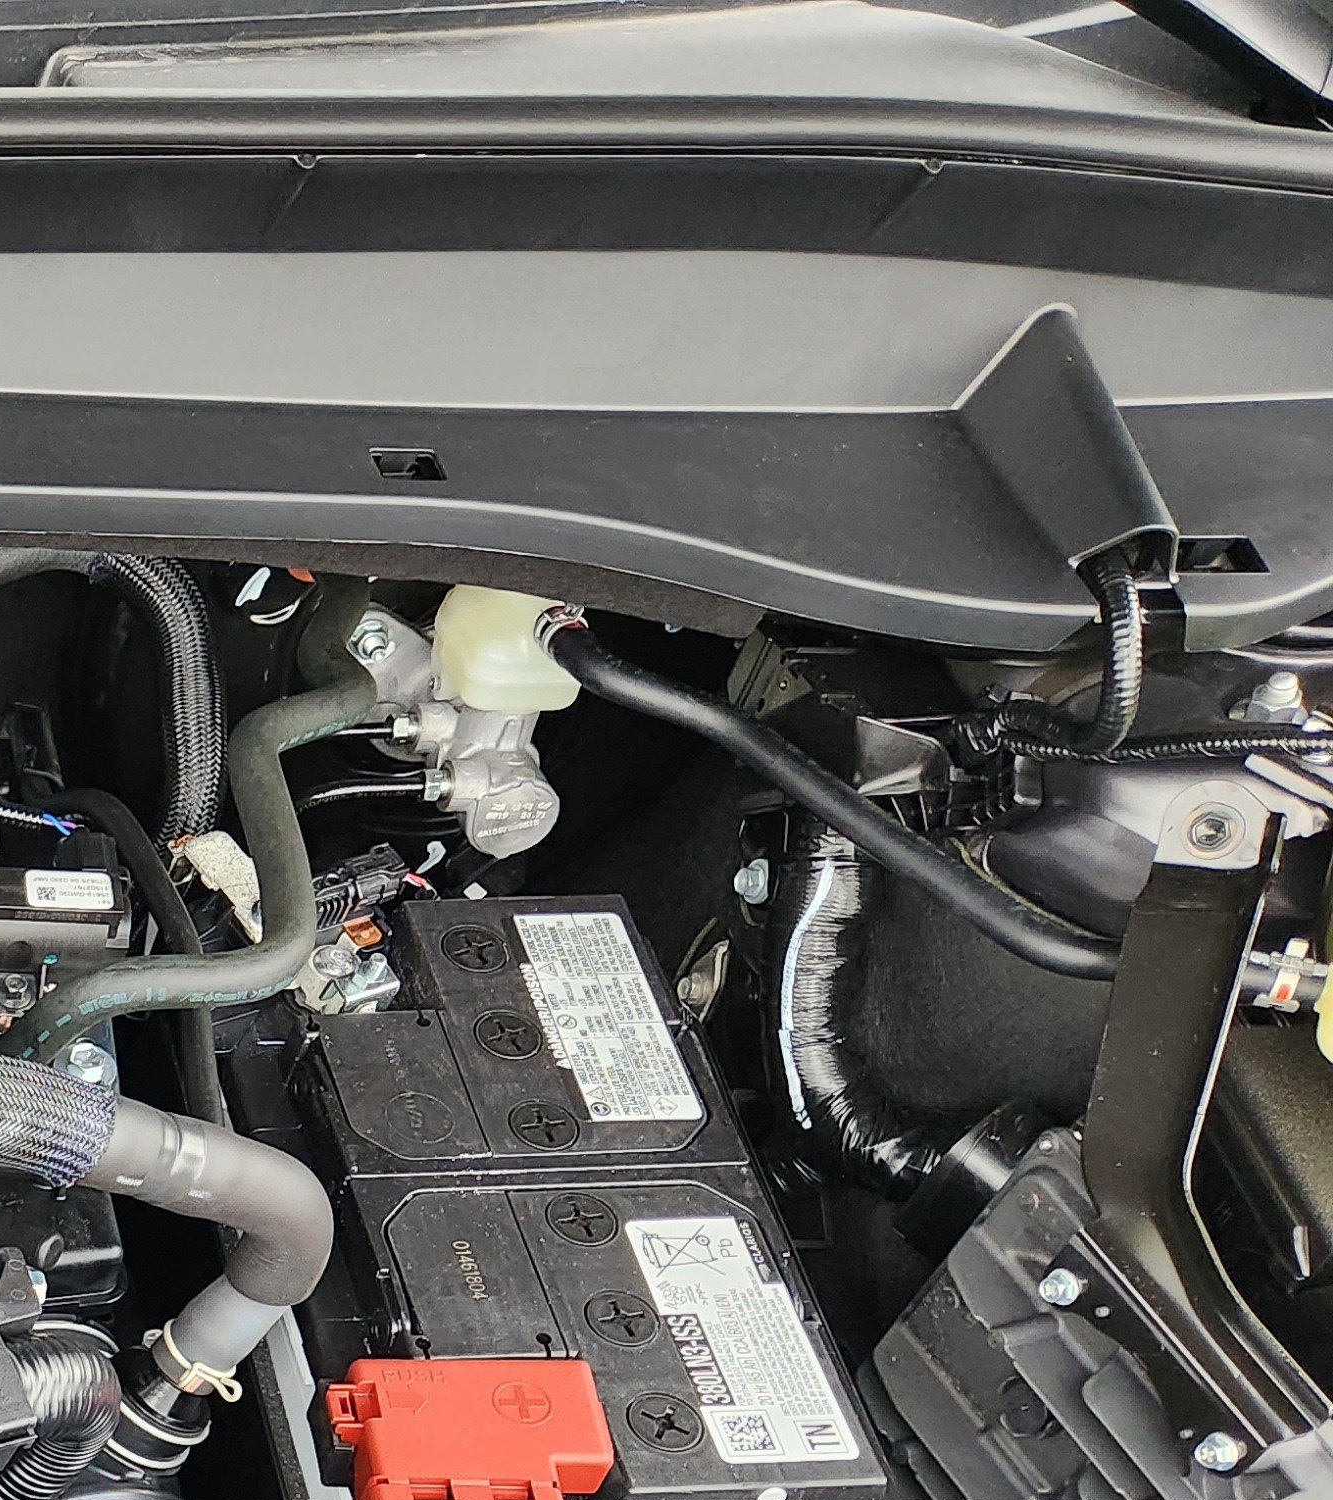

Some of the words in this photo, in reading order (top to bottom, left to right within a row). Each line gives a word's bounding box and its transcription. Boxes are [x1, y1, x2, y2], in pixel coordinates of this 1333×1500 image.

[714, 1238, 738, 1257] Pb
[737, 1221, 765, 1263] CLARIOS
[451, 1238, 488, 1302] 01461804
[665, 1315, 732, 1403] 380LN3-ISS
[800, 1424, 842, 1449] TN
